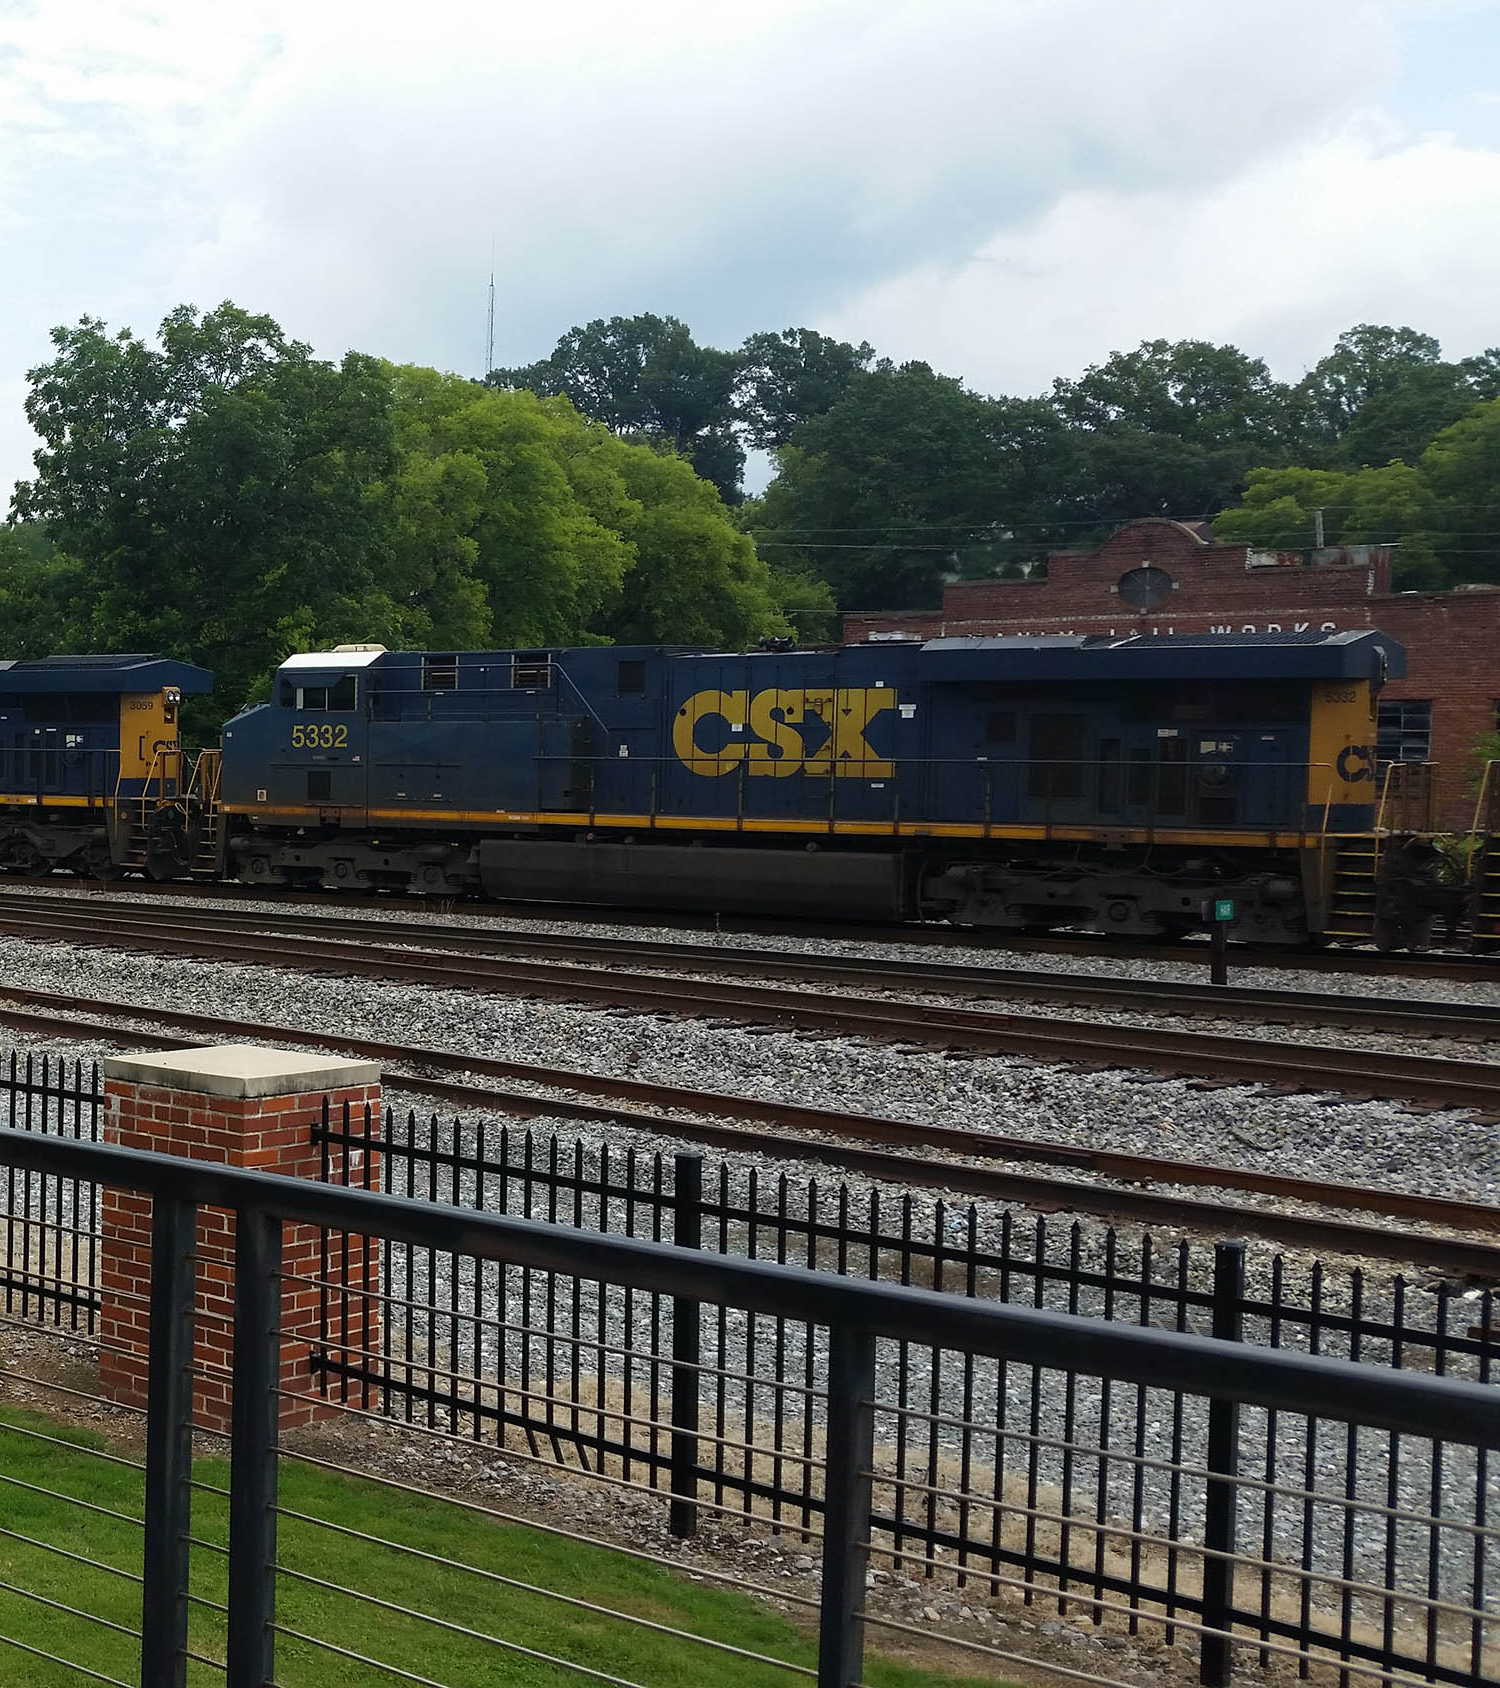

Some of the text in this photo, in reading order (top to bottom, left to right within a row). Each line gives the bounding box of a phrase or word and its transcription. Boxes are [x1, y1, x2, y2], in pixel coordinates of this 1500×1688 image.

[130, 701, 153, 710] 3059
[292, 724, 348, 748] 5332
[672, 688, 898, 779] CSX
